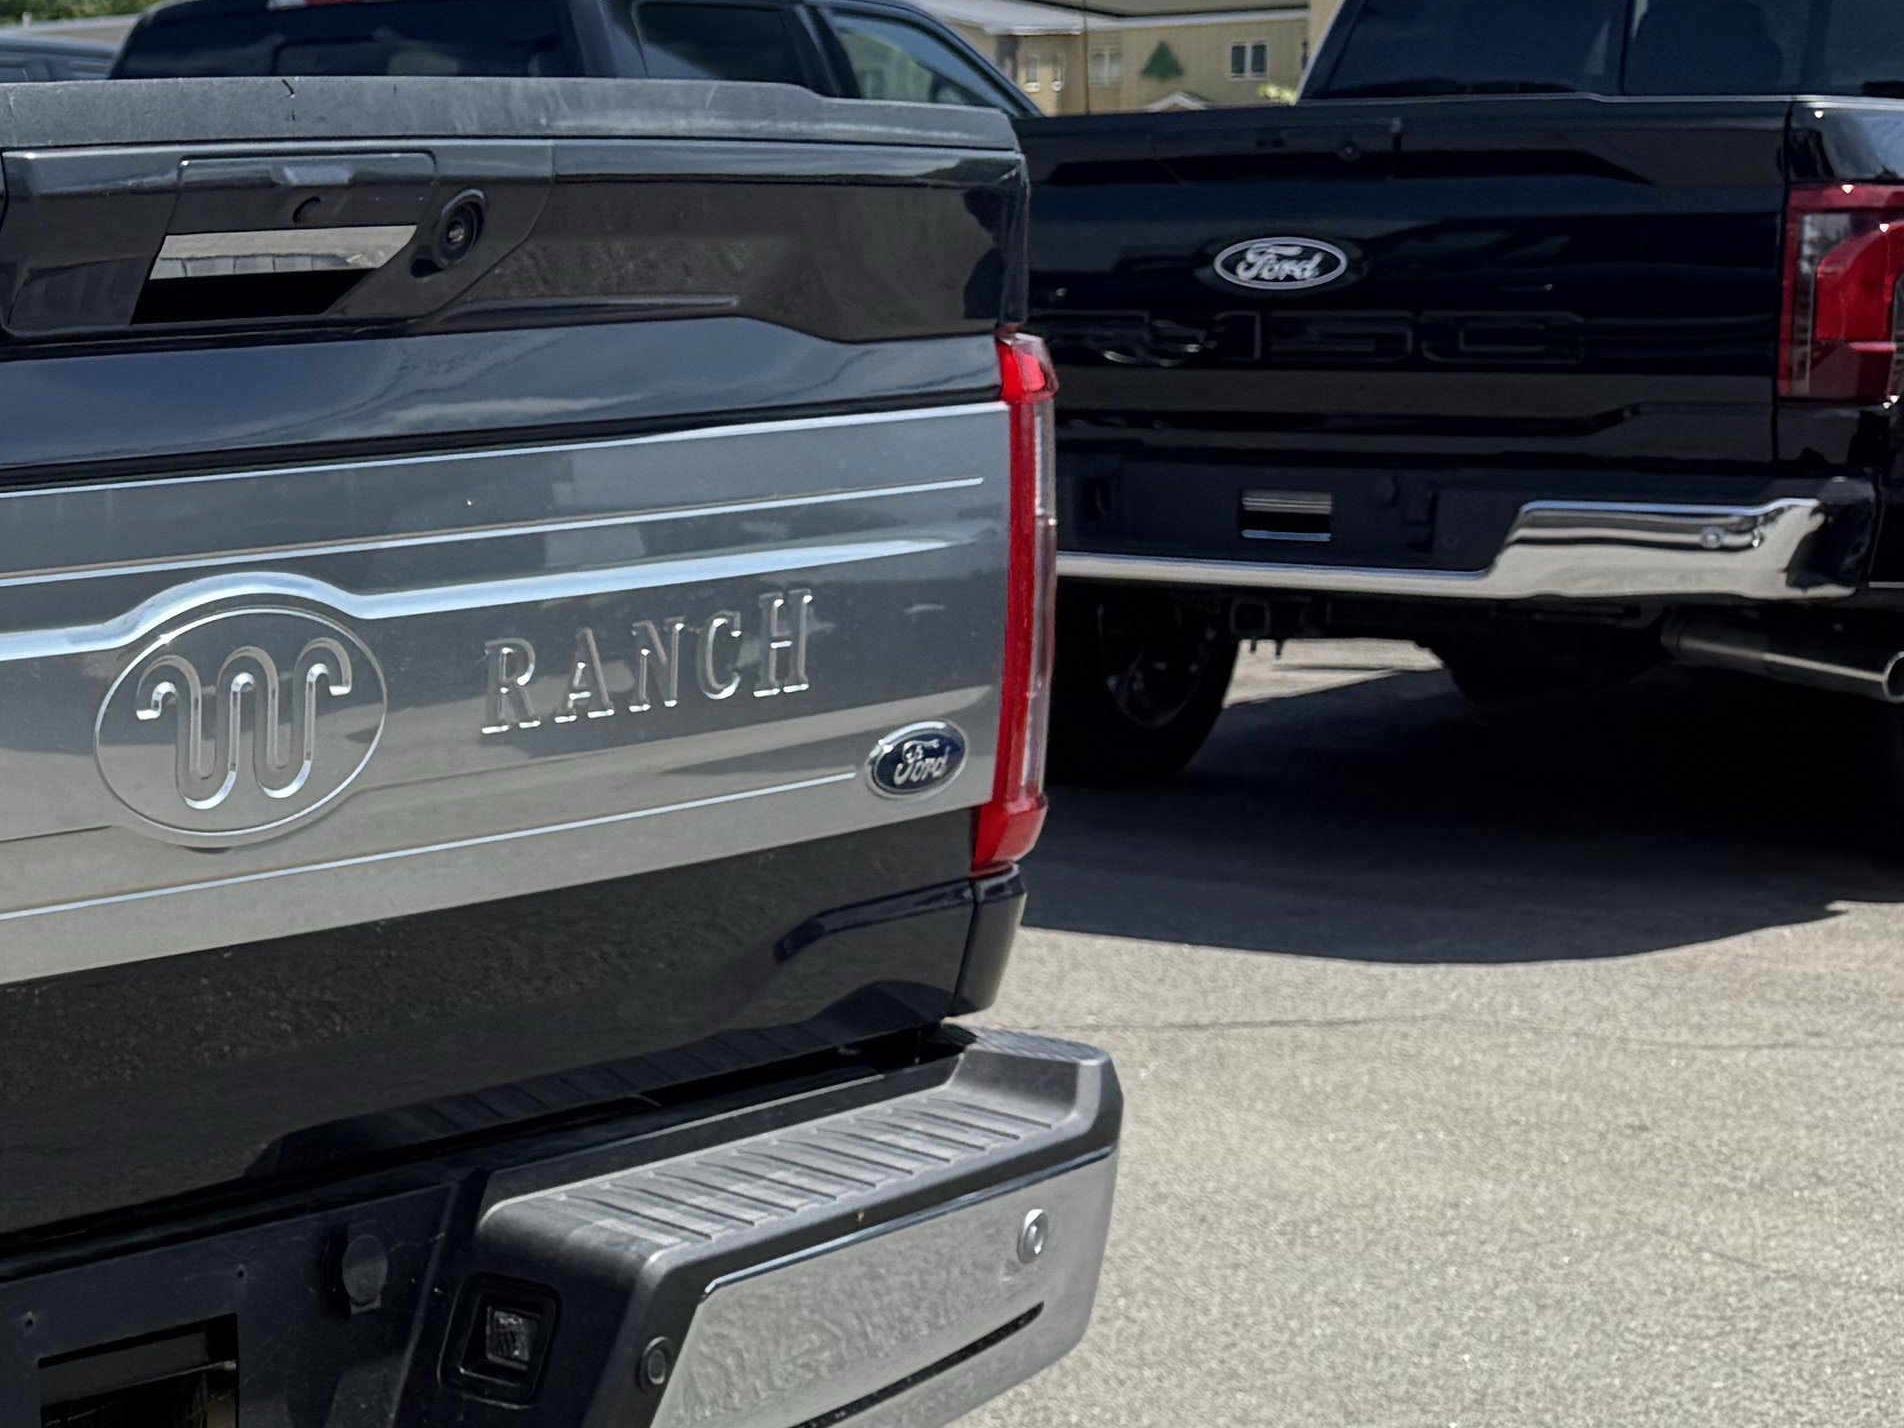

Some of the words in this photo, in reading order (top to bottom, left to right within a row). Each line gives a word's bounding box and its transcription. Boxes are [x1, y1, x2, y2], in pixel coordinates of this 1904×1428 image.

[1236, 243, 1324, 282] Ford
[481, 588, 815, 735] RANCH
[892, 737, 952, 786] Ford
